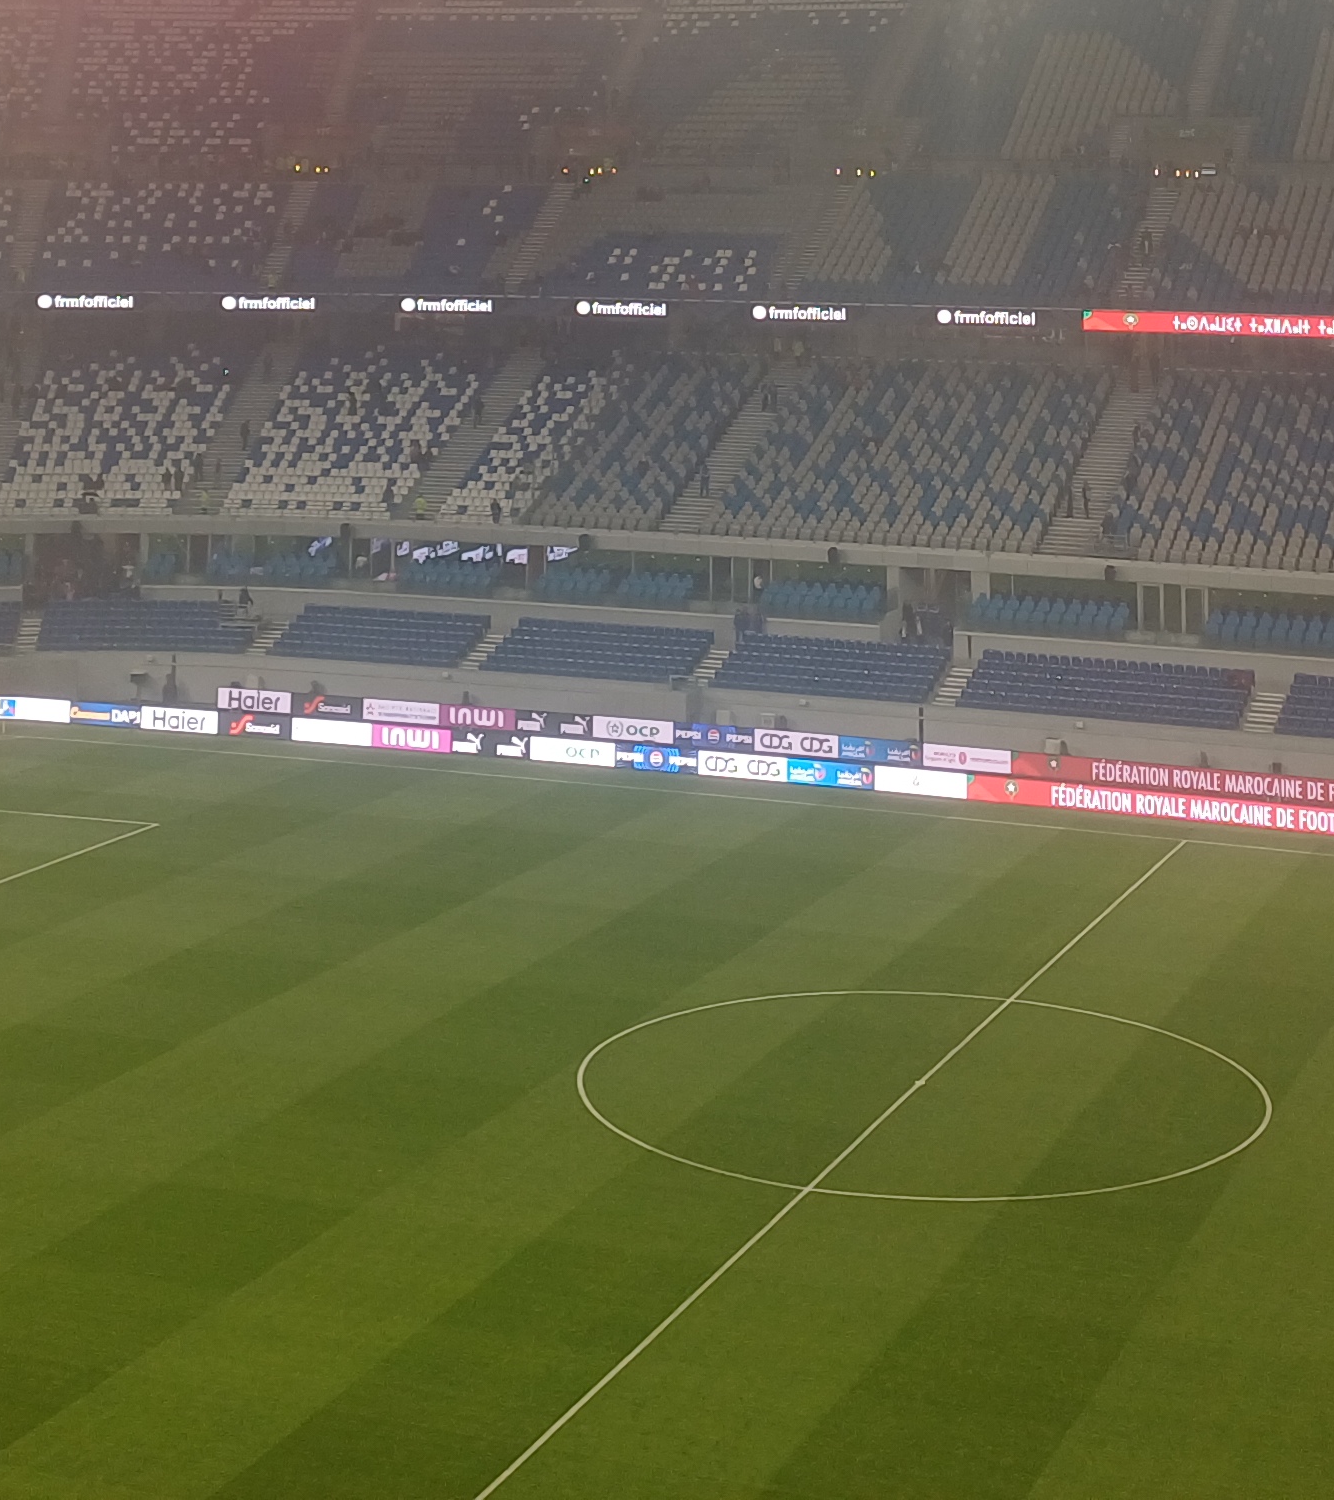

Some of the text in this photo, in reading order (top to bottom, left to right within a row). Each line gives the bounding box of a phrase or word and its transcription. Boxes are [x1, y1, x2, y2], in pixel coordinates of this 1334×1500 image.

[54, 294, 134, 309] frmfofficiel
[239, 296, 316, 310] frmfofficiel
[417, 298, 493, 313] frmfofficiel
[592, 301, 667, 317] frmfofficiel
[769, 305, 847, 321] frmfofficiel
[954, 309, 1036, 326] frmfofficiel
[228, 690, 281, 711] Haier
[153, 710, 205, 731] Haier
[449, 707, 505, 728] inwi
[381, 727, 440, 750] inwi
[626, 724, 660, 738] OCP
[760, 733, 793, 751] CDG
[800, 736, 833, 754] CDG
[705, 756, 738, 773] CDG
[747, 760, 780, 777] CDG
[1091, 758, 1169, 787] FÉDÉRATION
[1173, 768, 1221, 792] ROYALE
[1224, 774, 1303, 800] MAROCAINE
[1307, 780, 1325, 801] DE
[1051, 784, 1132, 813] FÉDÉRATION
[1136, 793, 1187, 818] ROYALE
[1190, 798, 1273, 827] MAROCAINE
[1276, 807, 1295, 829] DE
